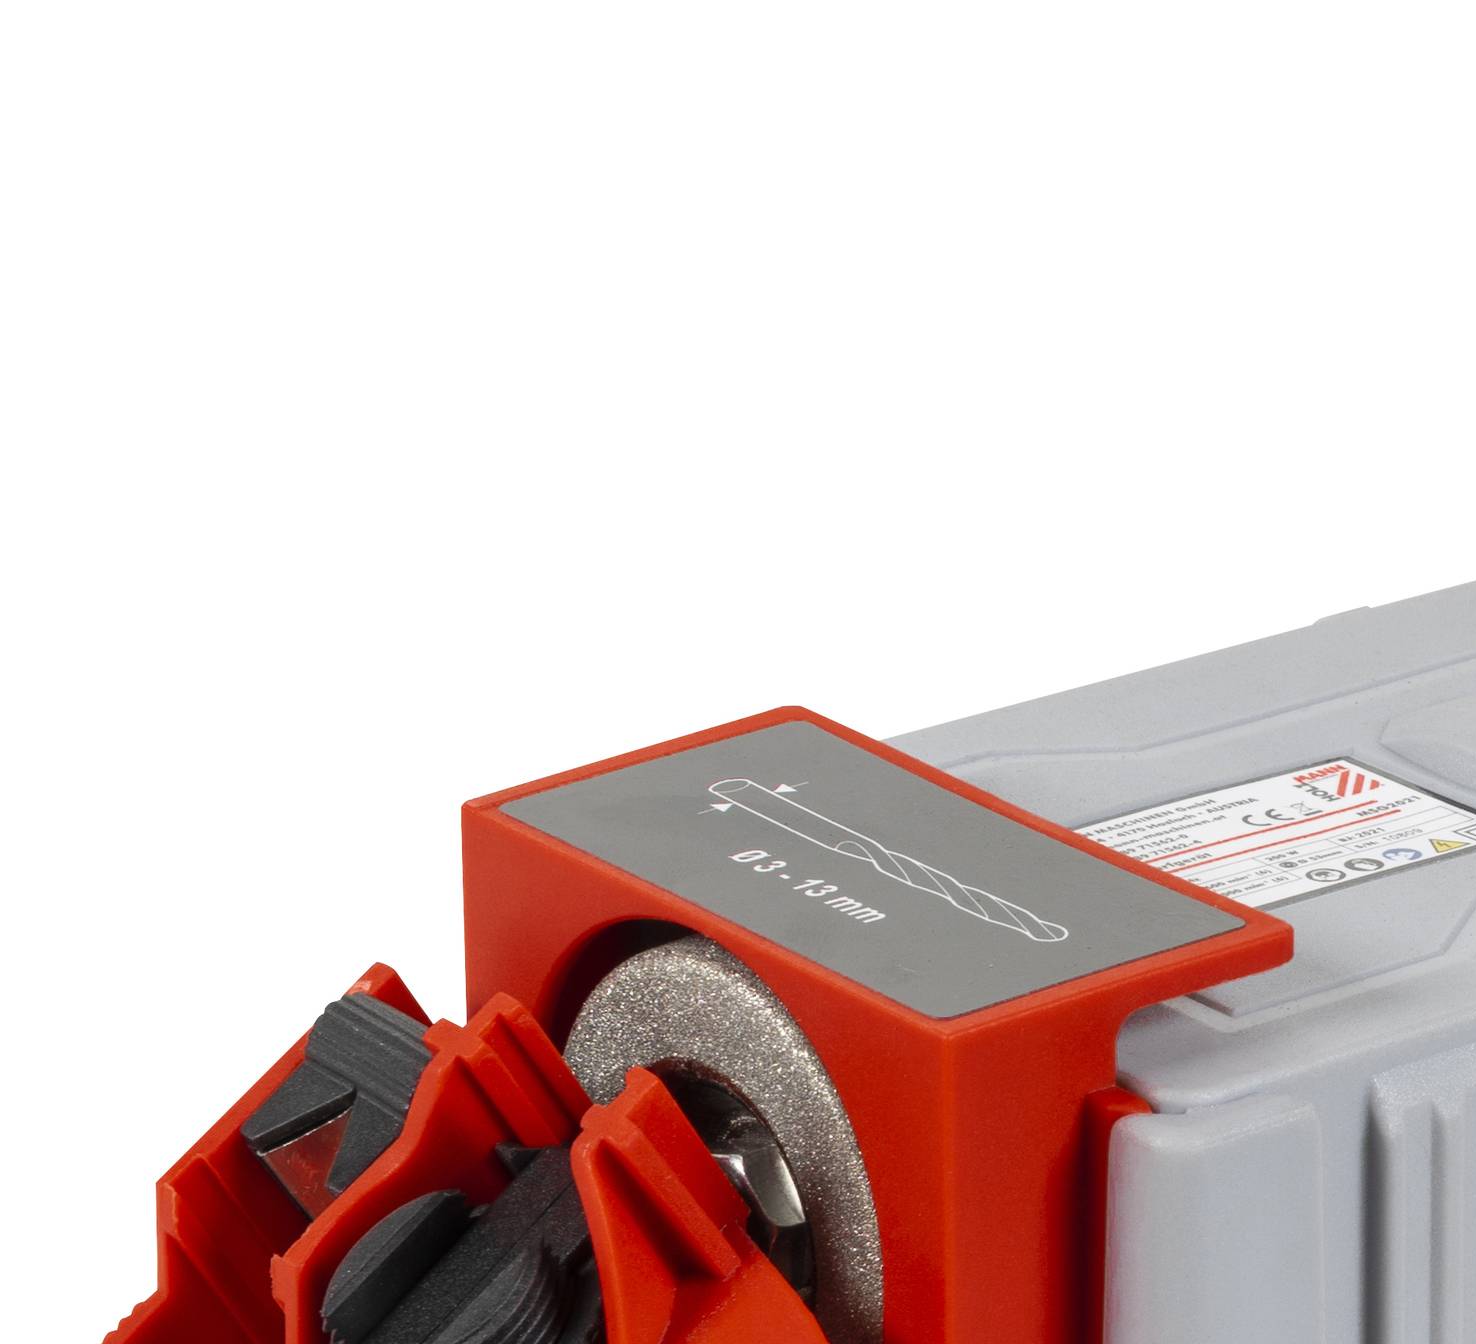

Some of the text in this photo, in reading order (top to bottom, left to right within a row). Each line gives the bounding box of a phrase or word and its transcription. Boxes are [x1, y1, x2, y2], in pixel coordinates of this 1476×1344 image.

[1094, 810, 1174, 835] MASCHINEN
[1175, 798, 1217, 812] GmbH
[1206, 797, 1256, 814] AUSTRIA
[793, 878, 839, 898] 13
[824, 897, 887, 924] mm
